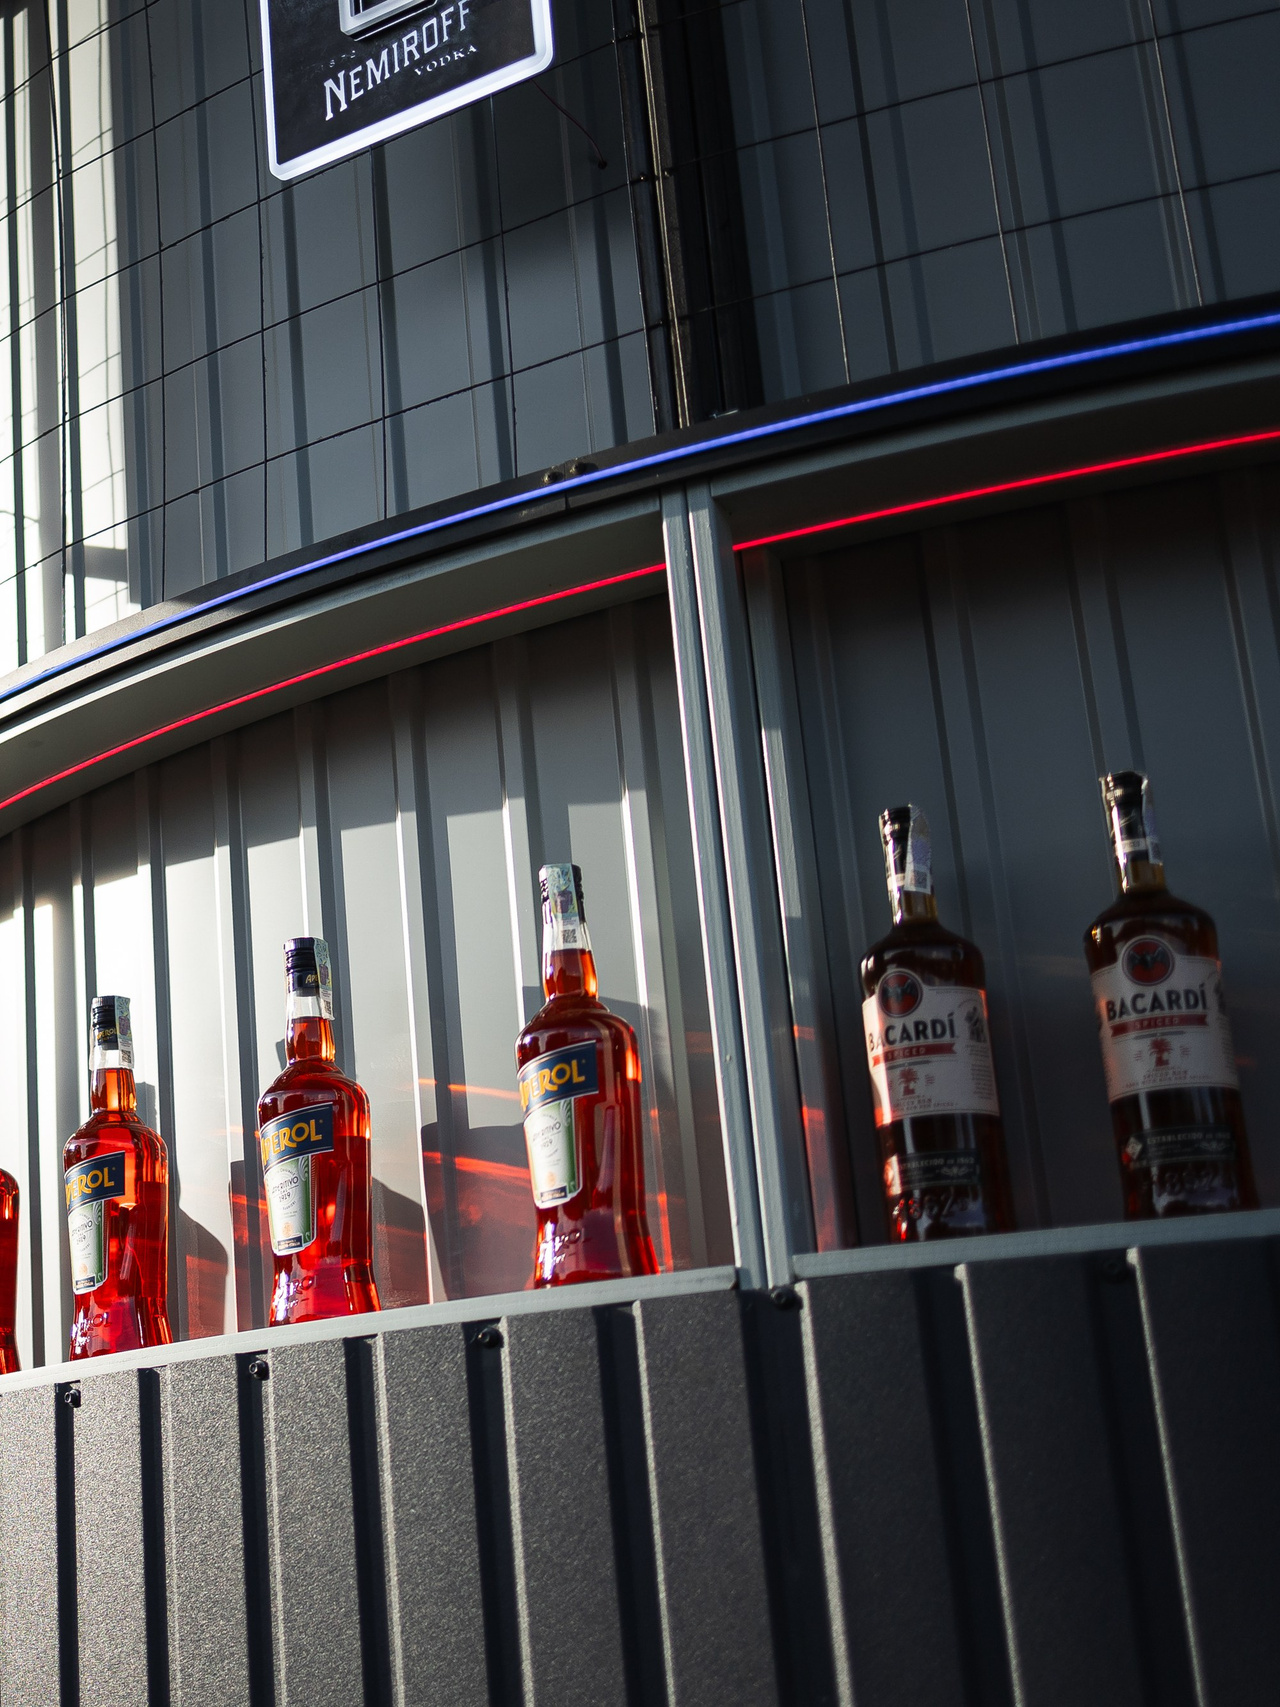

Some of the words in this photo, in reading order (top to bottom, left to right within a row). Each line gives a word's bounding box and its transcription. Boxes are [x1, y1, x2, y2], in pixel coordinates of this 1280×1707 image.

[323, 0, 470, 121] NEMIROFF
[414, 45, 477, 76] VODKA
[1106, 983, 1207, 1022] BACARDÍ
[868, 1012, 956, 1052] BACARDÍ
